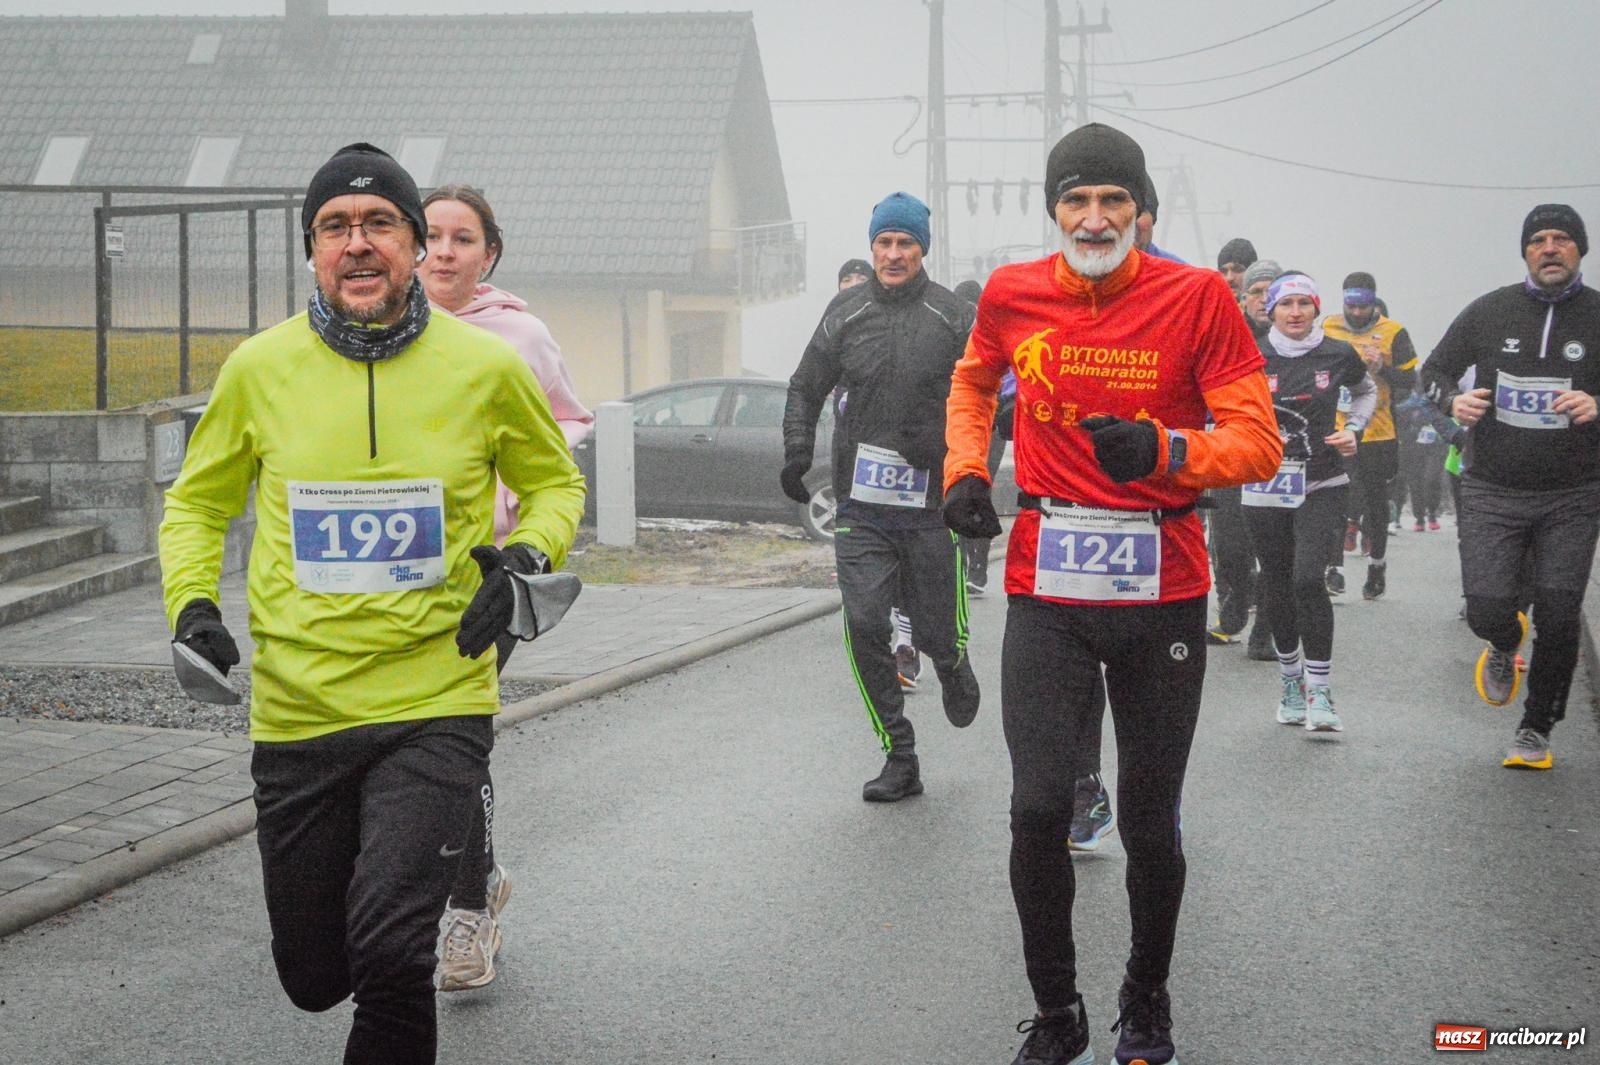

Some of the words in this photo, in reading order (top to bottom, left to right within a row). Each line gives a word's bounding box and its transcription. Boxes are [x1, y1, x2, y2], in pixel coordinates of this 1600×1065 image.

[350, 177, 374, 187] 4F
[1060, 345, 1159, 366] BYTOMSKI
[1060, 362, 1158, 379] półmaraton
[1106, 381, 1157, 390] 21.09.2014
[1507, 390, 1556, 413] 131
[865, 463, 914, 490] 184
[305, 488, 319, 496] Eko
[320, 488, 342, 496] Cross
[378, 485, 430, 494] Pietrowickiej
[318, 512, 416, 559] 199
[1058, 534, 1138, 572] 124
[481, 784, 493, 853] adidas
